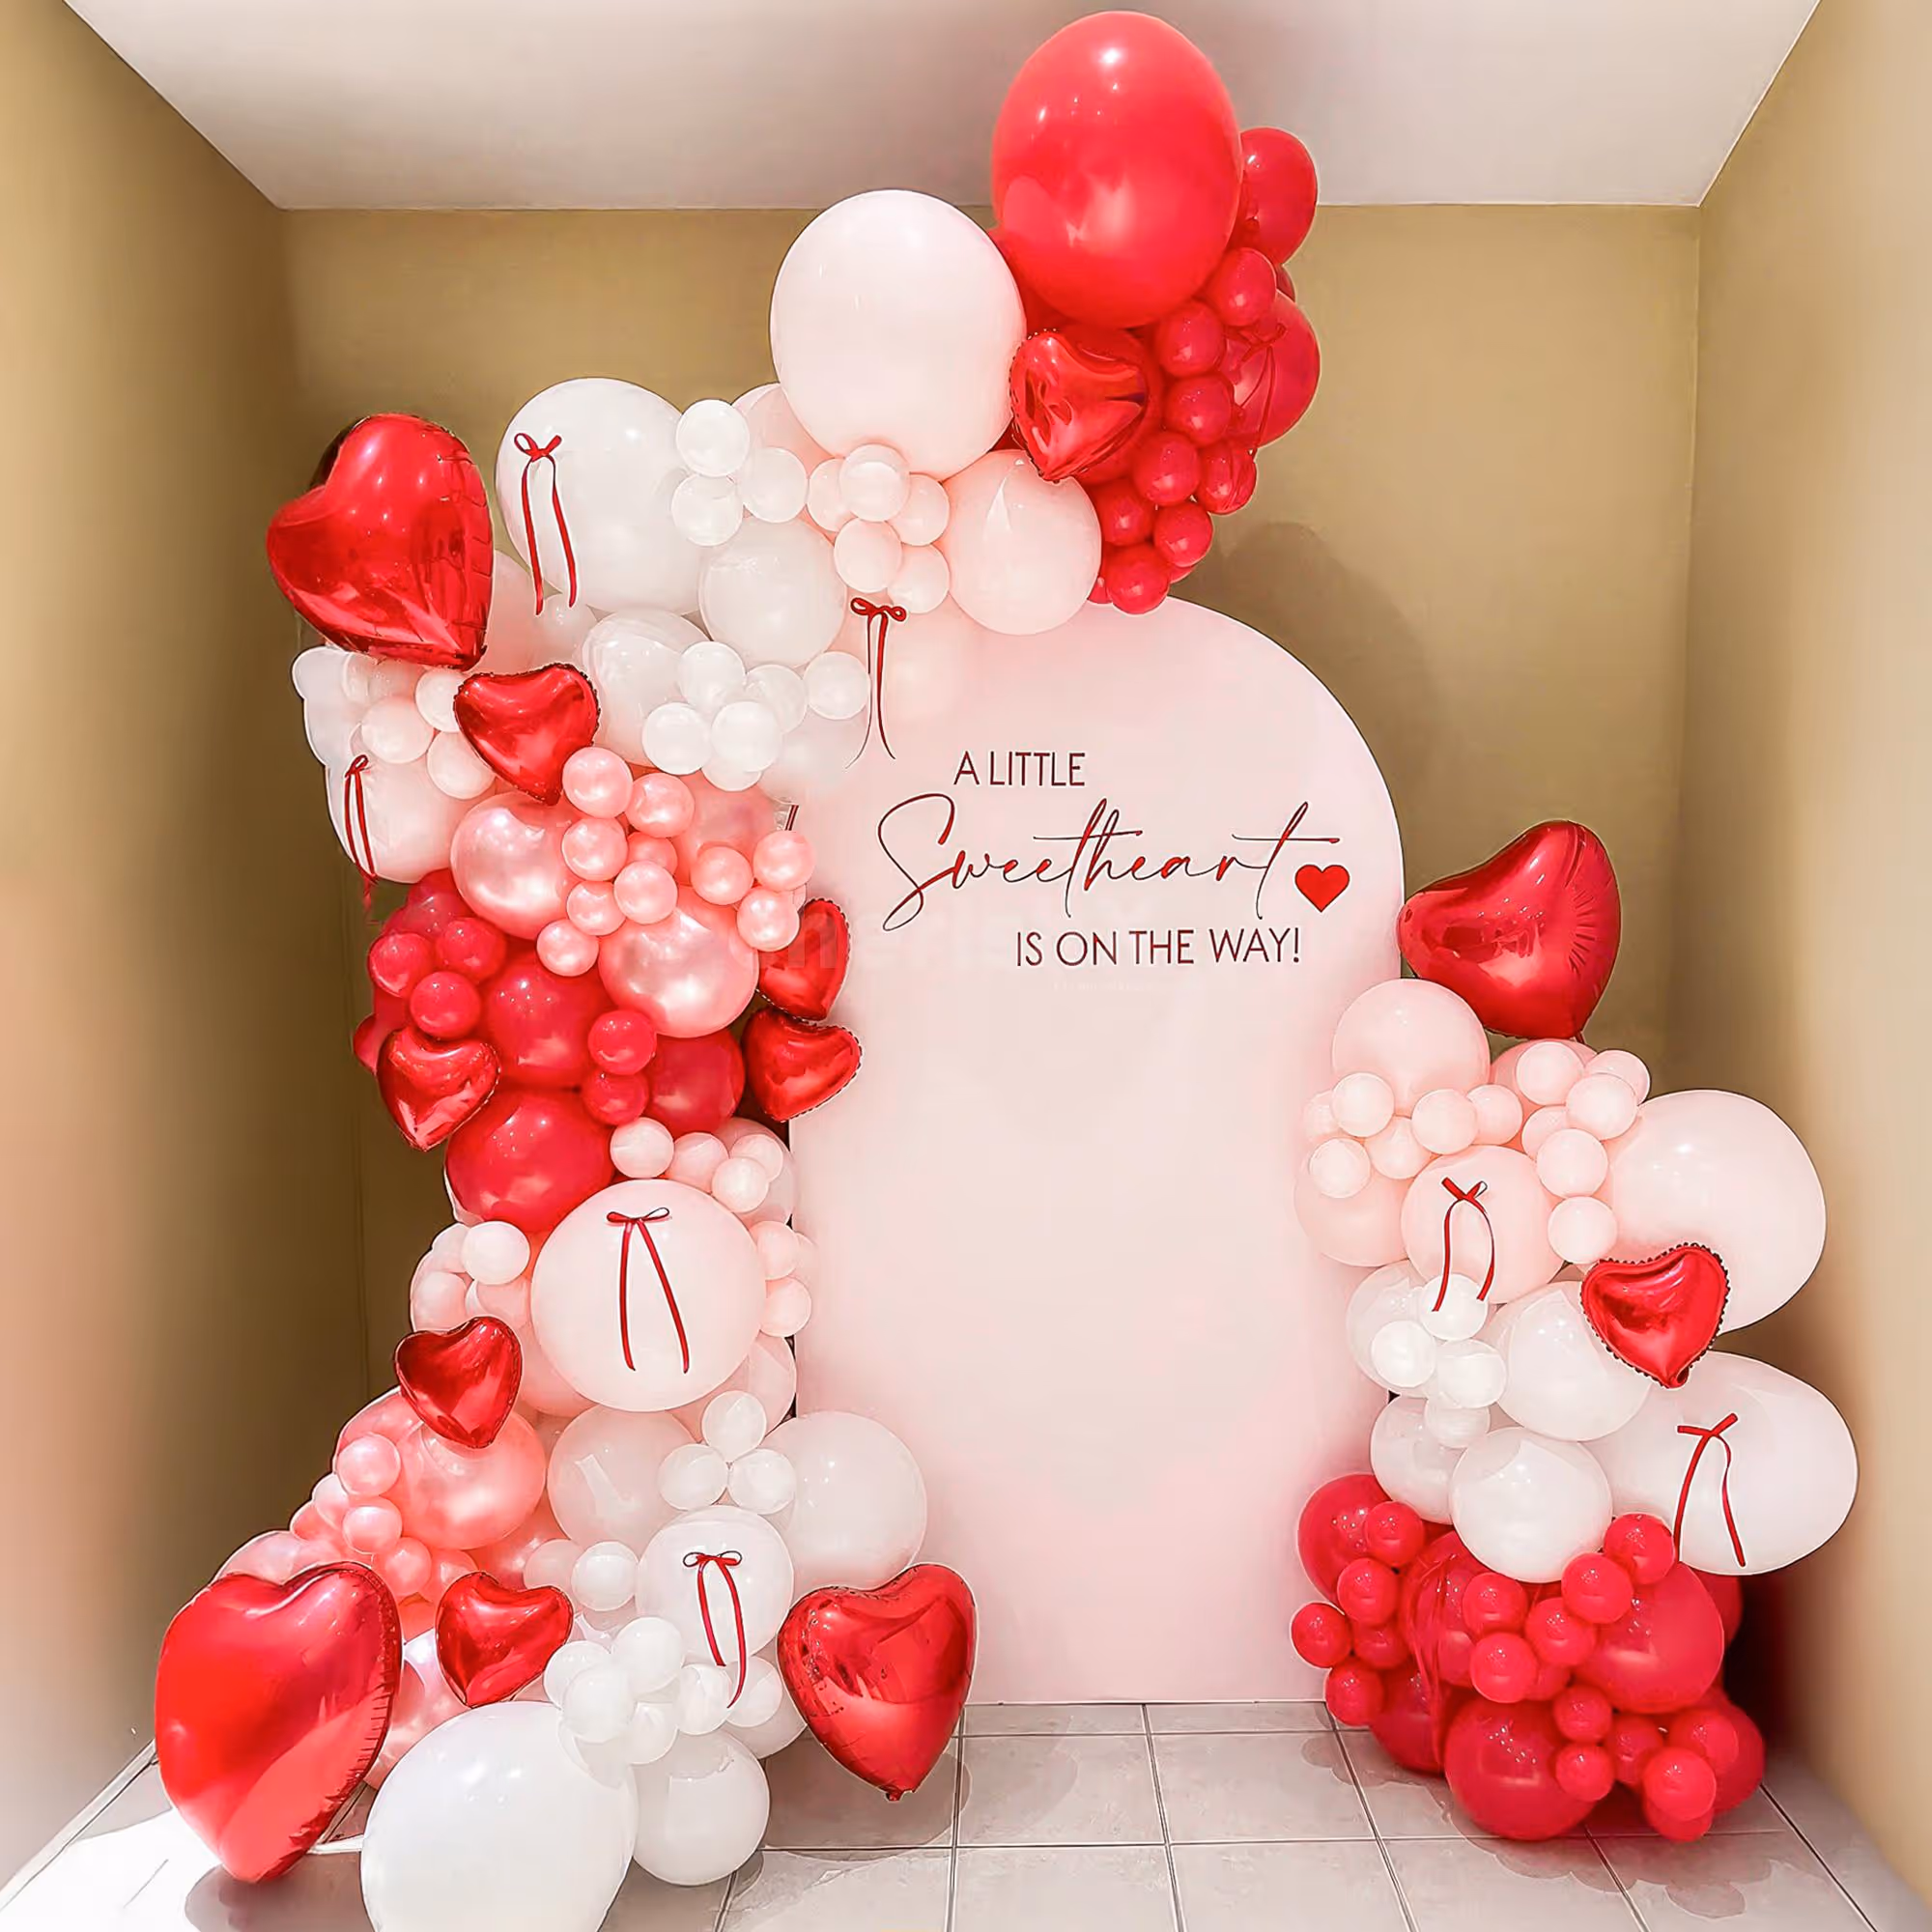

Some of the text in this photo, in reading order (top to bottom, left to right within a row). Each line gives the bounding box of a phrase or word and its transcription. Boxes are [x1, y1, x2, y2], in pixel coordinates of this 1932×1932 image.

[952, 750, 1086, 786] A LITTLE
[877, 792, 1341, 932] Sweetheart
[1016, 926, 1300, 967] IS ON THE WAY!
